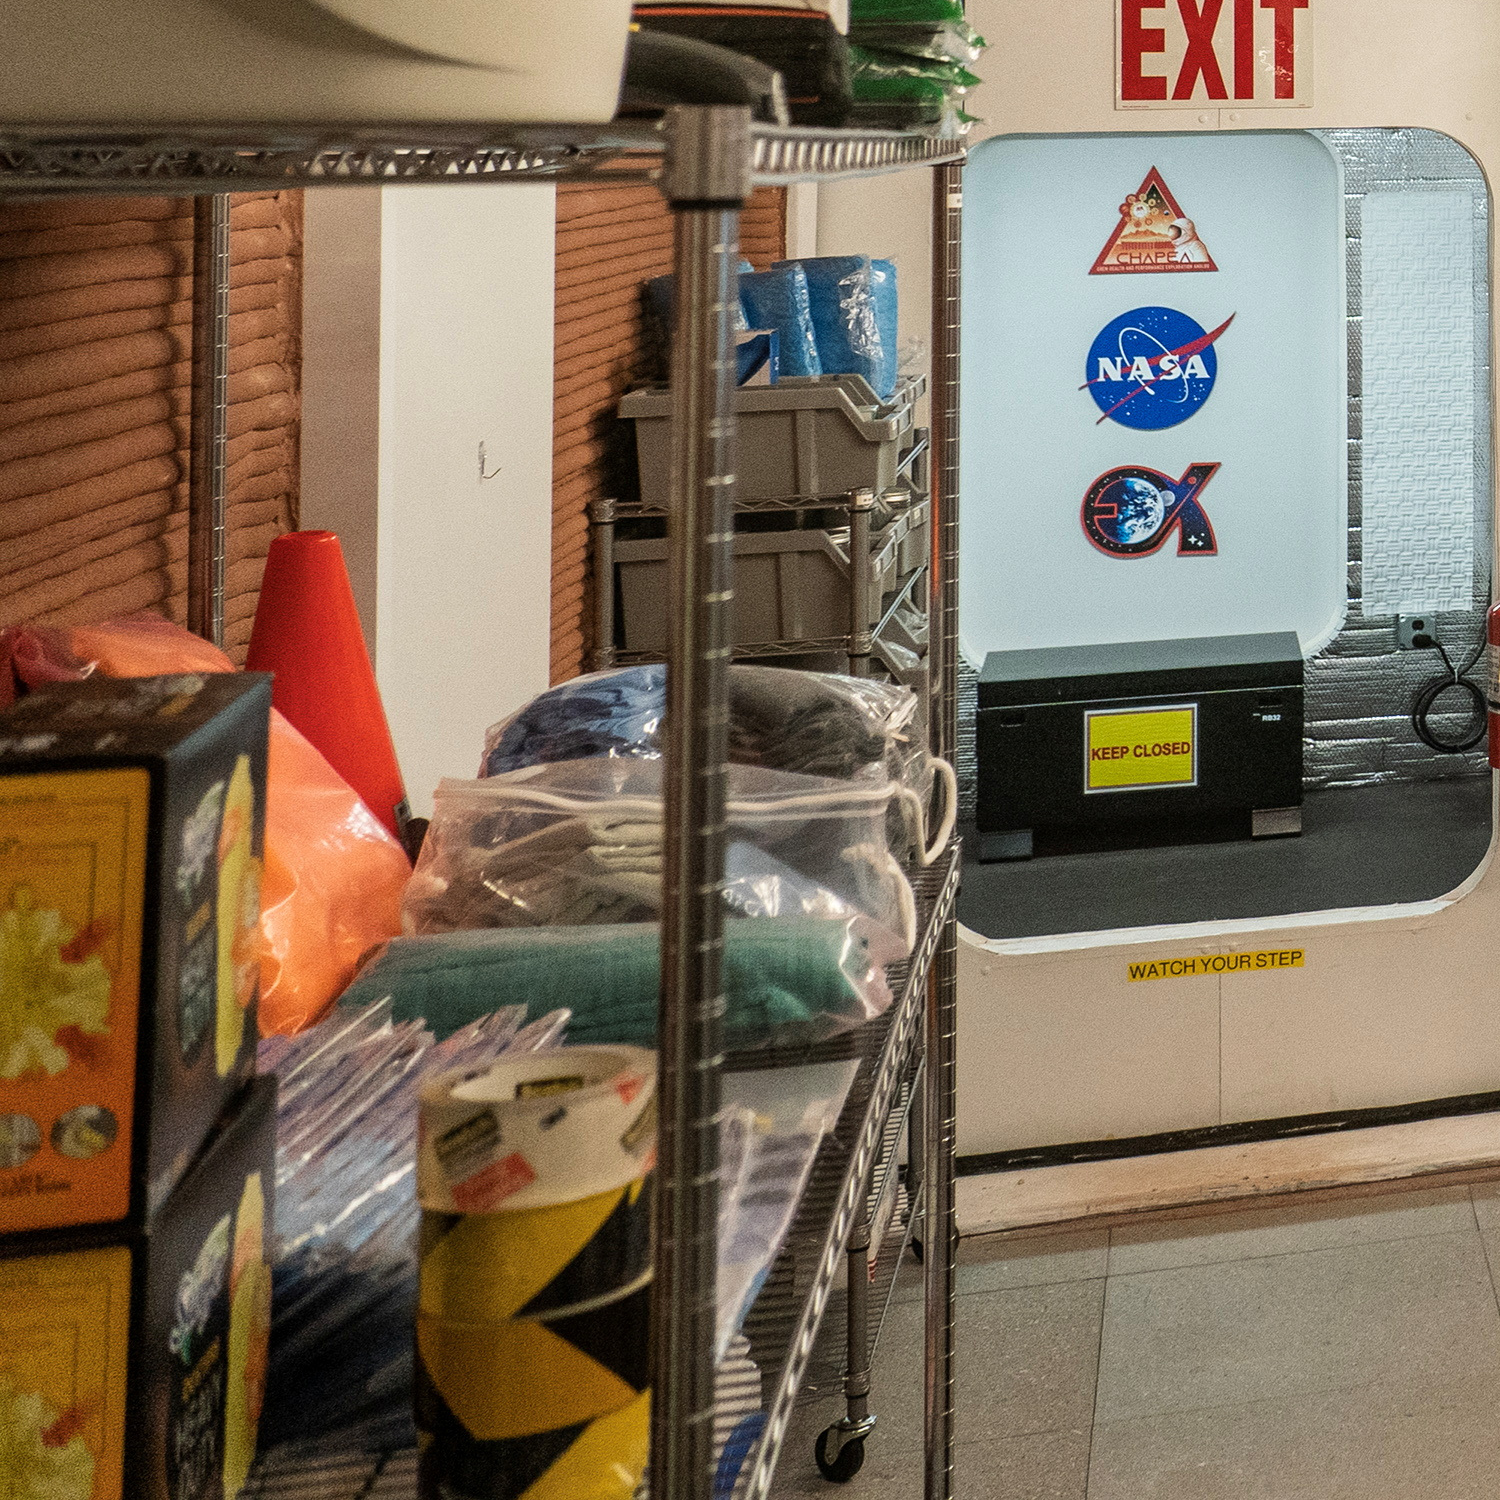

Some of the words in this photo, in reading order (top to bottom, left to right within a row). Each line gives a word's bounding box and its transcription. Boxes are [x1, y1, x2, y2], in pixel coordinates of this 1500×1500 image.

[1116, 251, 1191, 265] CHAPEA
[1097, 354, 1211, 382] NASA
[1091, 746, 1130, 761] KEEP
[1133, 741, 1191, 758] CLOSED
[1129, 960, 1196, 979] WATCH
[1200, 954, 1251, 972] YOUR
[1255, 950, 1302, 968] STEP
